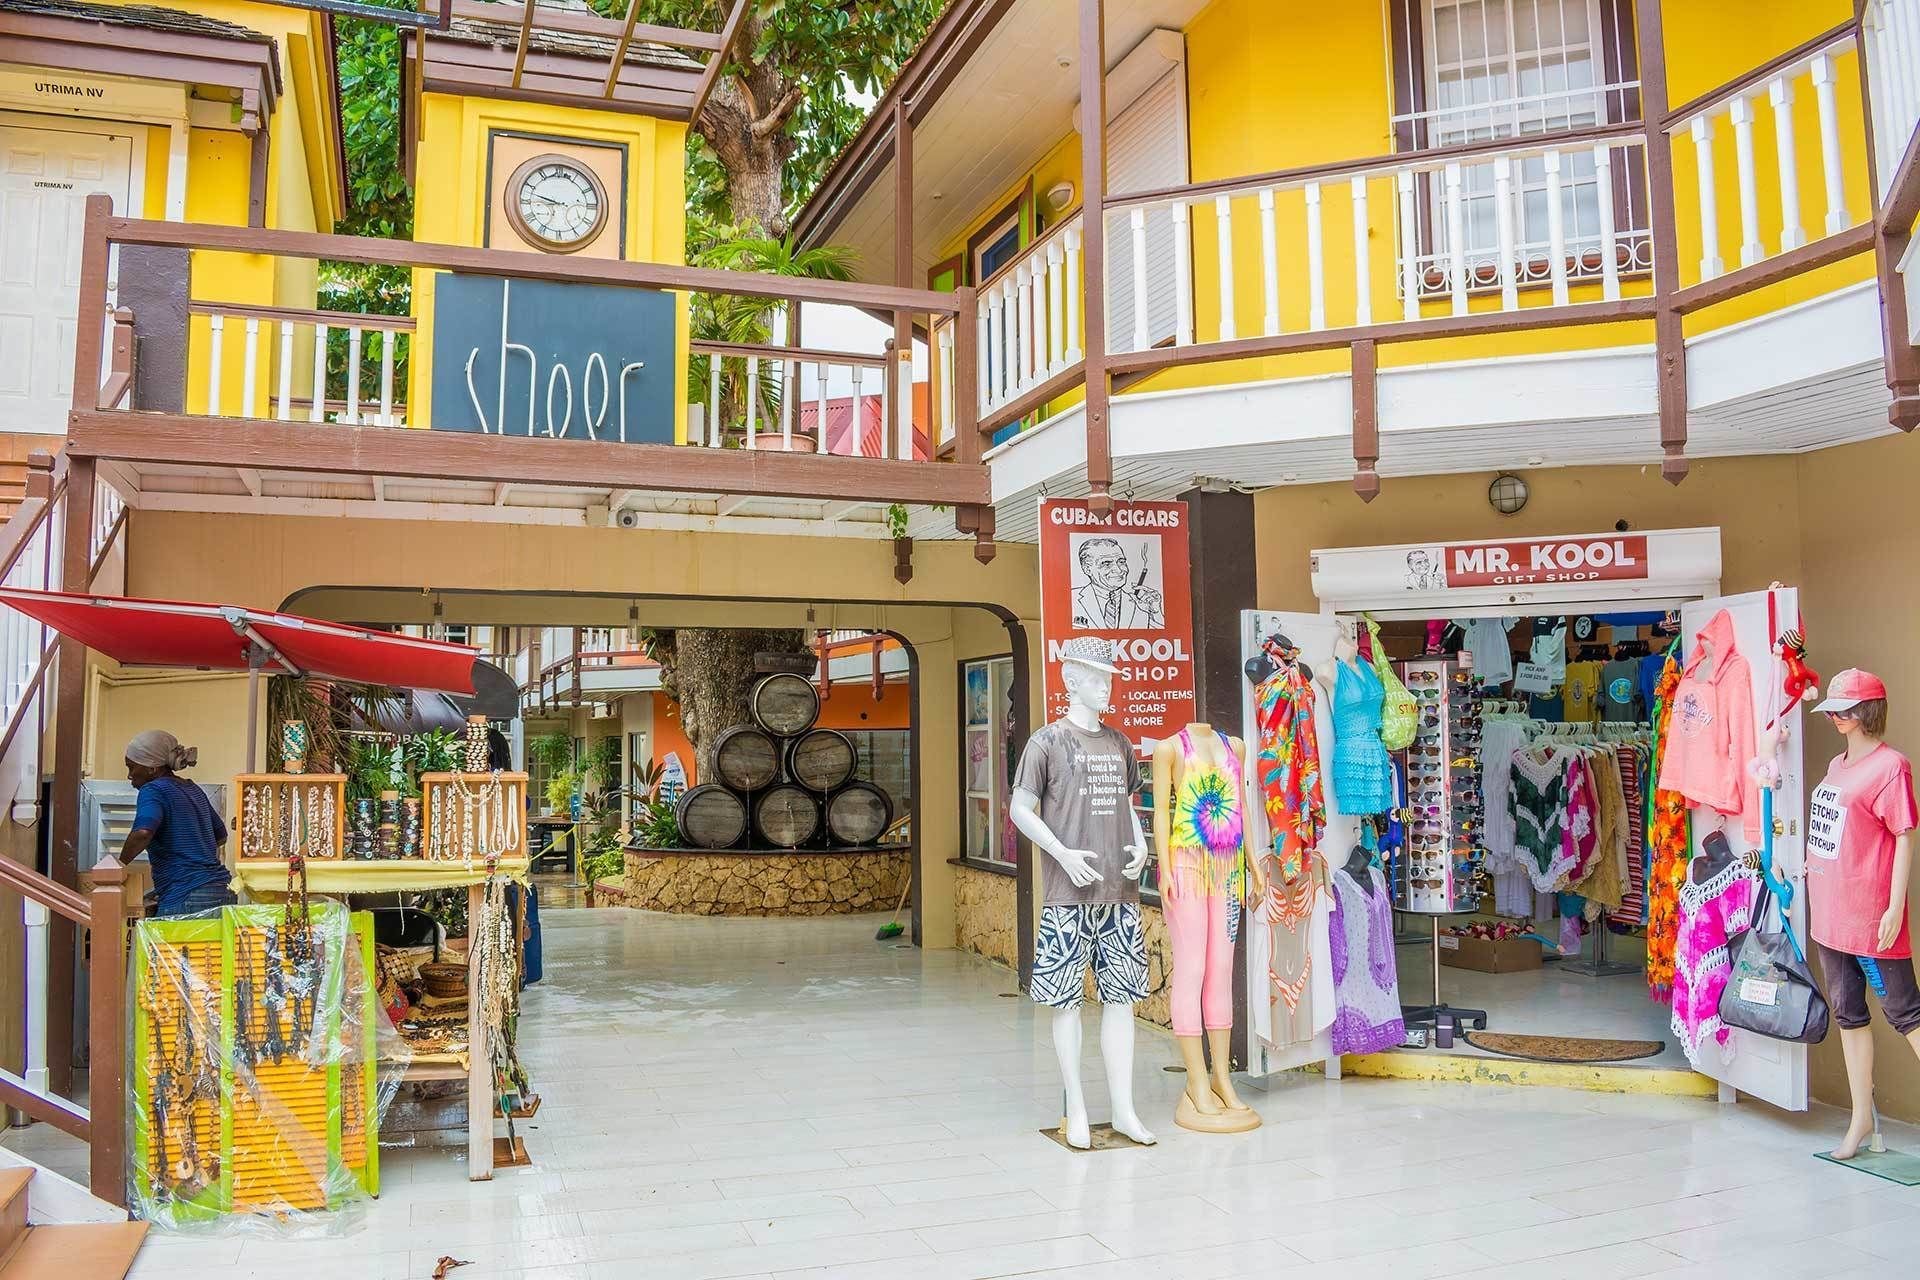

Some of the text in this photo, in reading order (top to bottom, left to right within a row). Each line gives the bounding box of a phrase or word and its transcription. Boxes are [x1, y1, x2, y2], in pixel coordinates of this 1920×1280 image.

[34, 82, 104, 98] UTRIMA NV
[34, 181, 61, 189] UTRIMA
[1116, 509, 1180, 528] CIGARS
[1455, 540, 1636, 575] MR. KOOL
[1493, 572, 1600, 584] GIFT SHOP
[1111, 638, 1190, 663] KOOL
[1121, 666, 1179, 682] SHOP
[1128, 690, 1193, 701] LOCAL ITEMS
[1128, 703, 1167, 713] CIGARS
[1123, 716, 1163, 727] & MORE
[1091, 761, 1107, 772] could
[1108, 761, 1117, 772] be
[1087, 772, 1124, 786] anything,
[1092, 783, 1117, 795] became
[1816, 788, 1837, 803] I PUT
[1810, 802, 1840, 823] ETCHUP
[1811, 819, 1821, 832] ON
